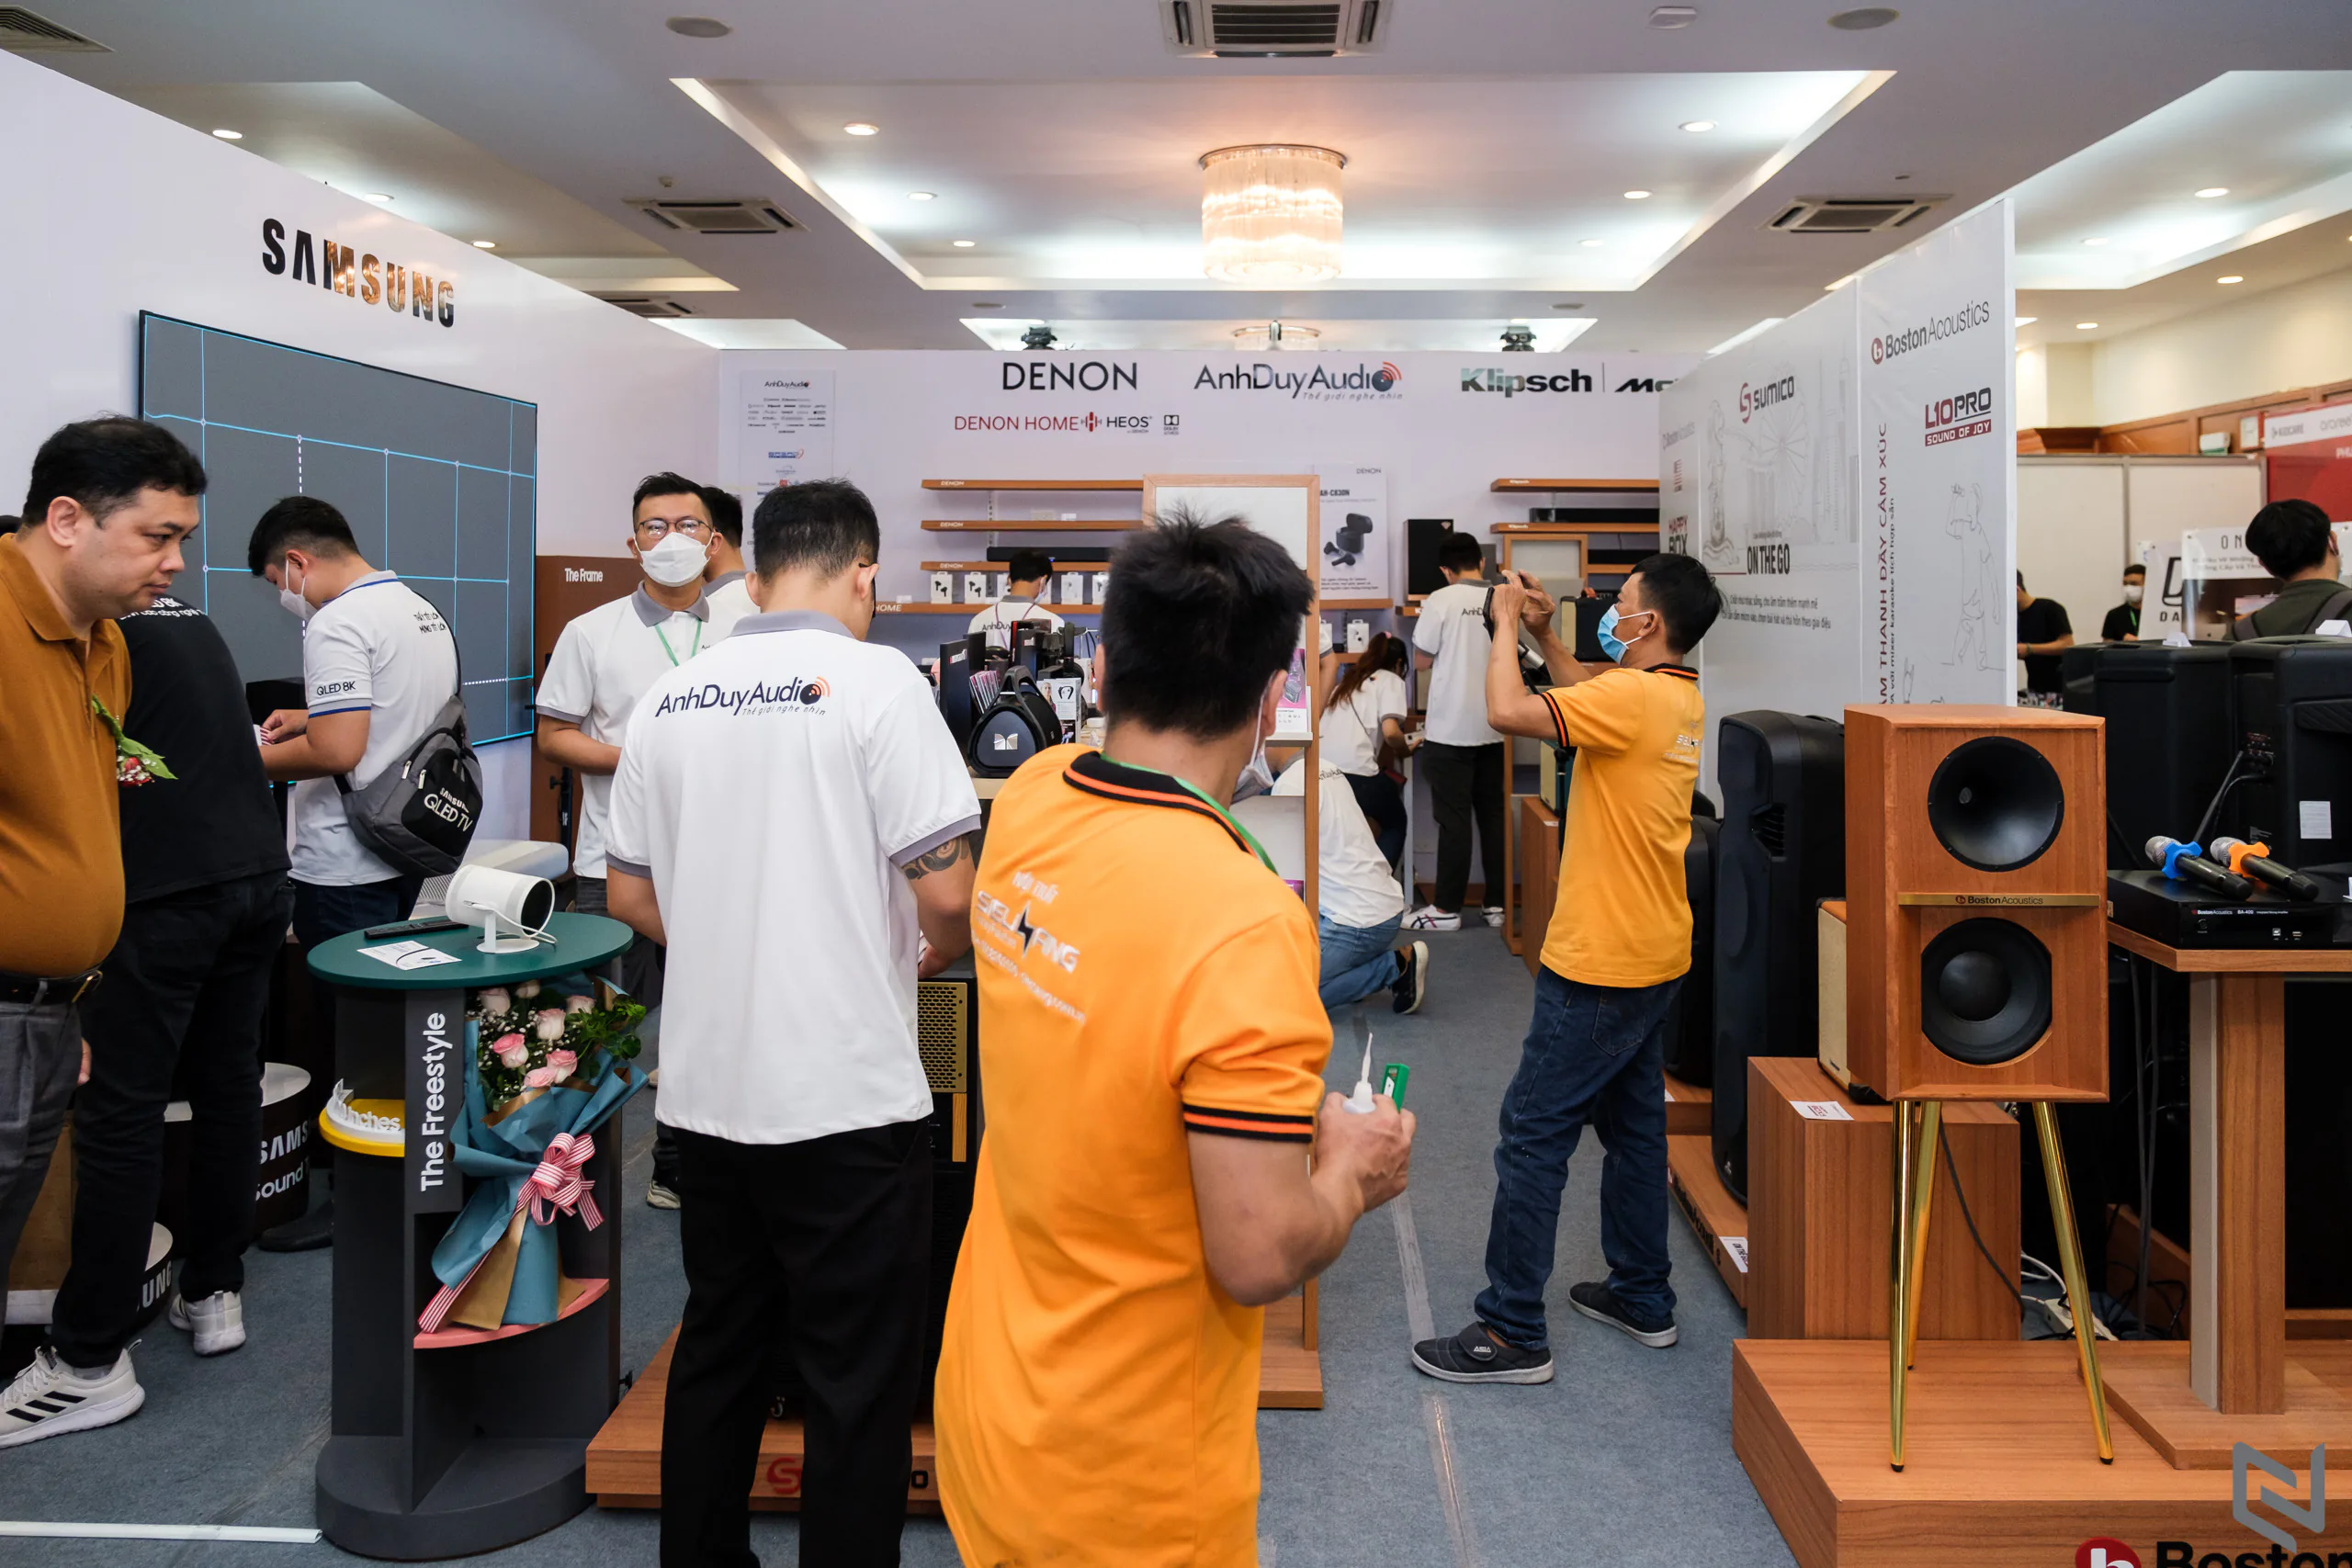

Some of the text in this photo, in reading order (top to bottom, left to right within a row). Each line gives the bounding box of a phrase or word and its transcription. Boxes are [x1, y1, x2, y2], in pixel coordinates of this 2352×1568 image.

[262, 218, 455, 328] SAMSUNG
[1886, 300, 1990, 359] BostonAcoustics
[1002, 362, 1137, 391] DENON
[1193, 363, 1395, 400] AnhDuyAudio
[1461, 368, 1592, 398] Klipsch
[1614, 378, 1679, 393] Mc
[955, 416, 1079, 431] DENON HOME
[1106, 416, 1149, 428] HEOS
[1927, 422, 1991, 446] SOUND OF JOY
[1747, 543, 1791, 575] ON THE GO
[565, 568, 604, 582] The Frame
[1462, 606, 1484, 616] AnhD
[982, 621, 1012, 632] AnhDuy
[316, 681, 356, 696] QLED 8K
[655, 676, 822, 717] AnhDuyAudio
[776, 705, 800, 714] nghe
[424, 793, 473, 832] QLED TV
[1968, 896, 2043, 905] BostonAcoustics
[420, 1012, 454, 1192] The Freestyle
[260, 1120, 310, 1165] SAMS
[137, 1259, 172, 1312] UNG
